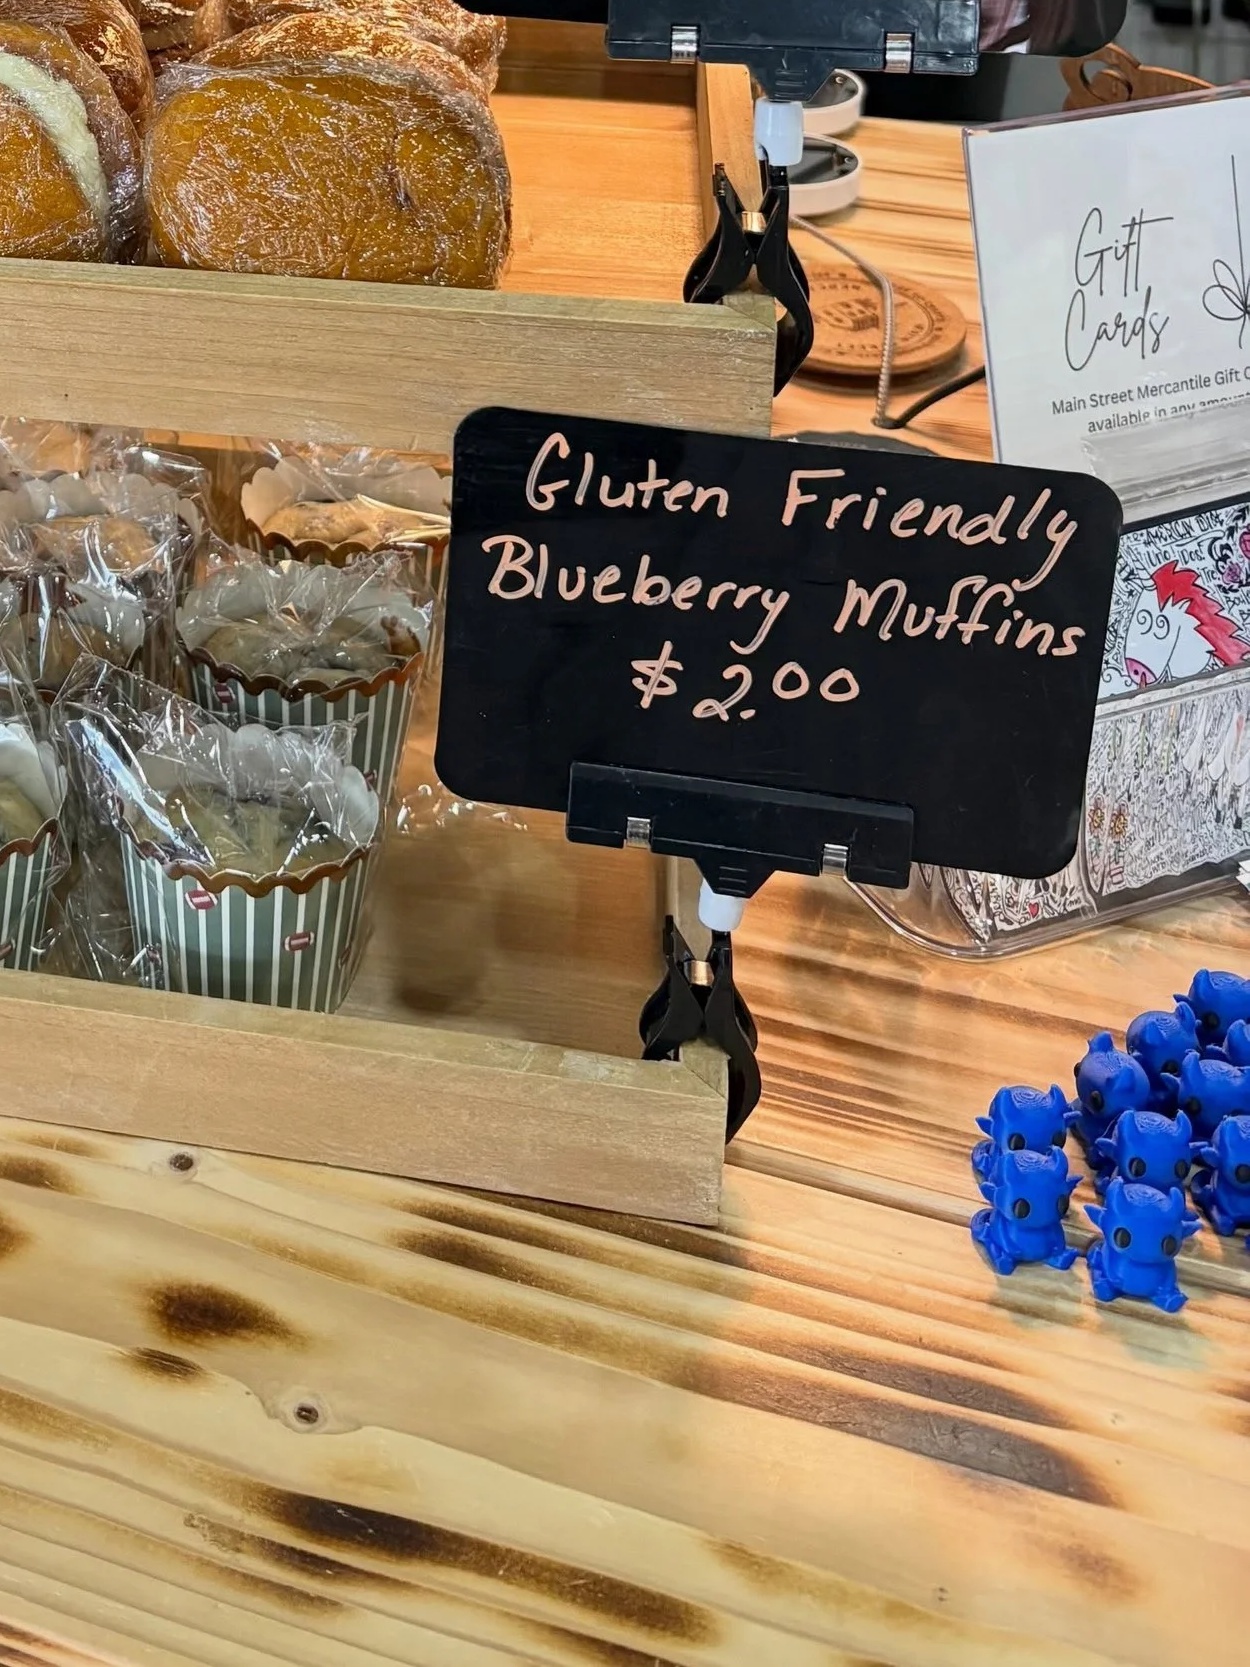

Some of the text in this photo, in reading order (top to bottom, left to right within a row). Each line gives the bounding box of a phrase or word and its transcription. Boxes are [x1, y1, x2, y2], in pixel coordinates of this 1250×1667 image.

[1075, 207, 1174, 297] Gift
[1065, 285, 1169, 371] Cards
[1052, 397, 1086, 415] Main
[1090, 389, 1134, 408] Street
[1137, 374, 1211, 398] Mercantile
[1215, 369, 1240, 386] Gift
[1088, 409, 1151, 433] available
[1154, 407, 1167, 418] in
[525, 432, 1079, 593] Gluten Friendly
[481, 534, 1086, 658] Blueberry Muffins
